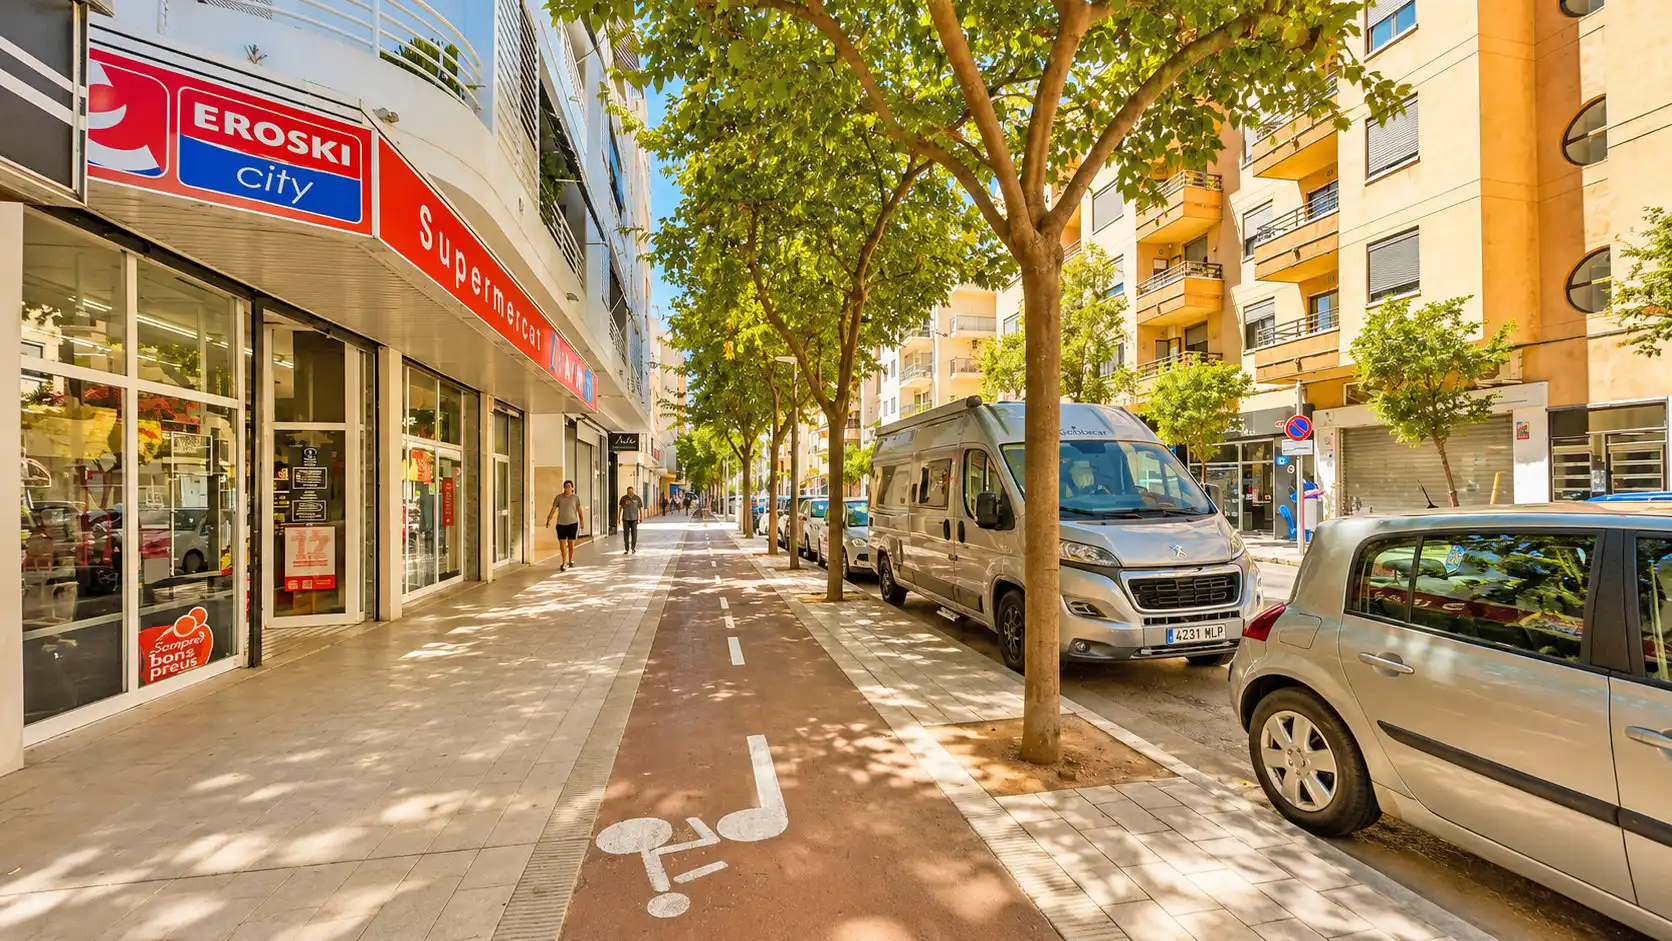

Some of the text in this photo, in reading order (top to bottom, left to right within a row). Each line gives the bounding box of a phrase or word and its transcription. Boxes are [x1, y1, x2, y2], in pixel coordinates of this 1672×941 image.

[194, 101, 351, 167] EROSKI
[236, 164, 314, 205] city
[418, 204, 543, 352] Supermercat
[1175, 626, 1224, 641] 4231 MLP
[149, 648, 195, 668] bons
[150, 657, 198, 682] preus
